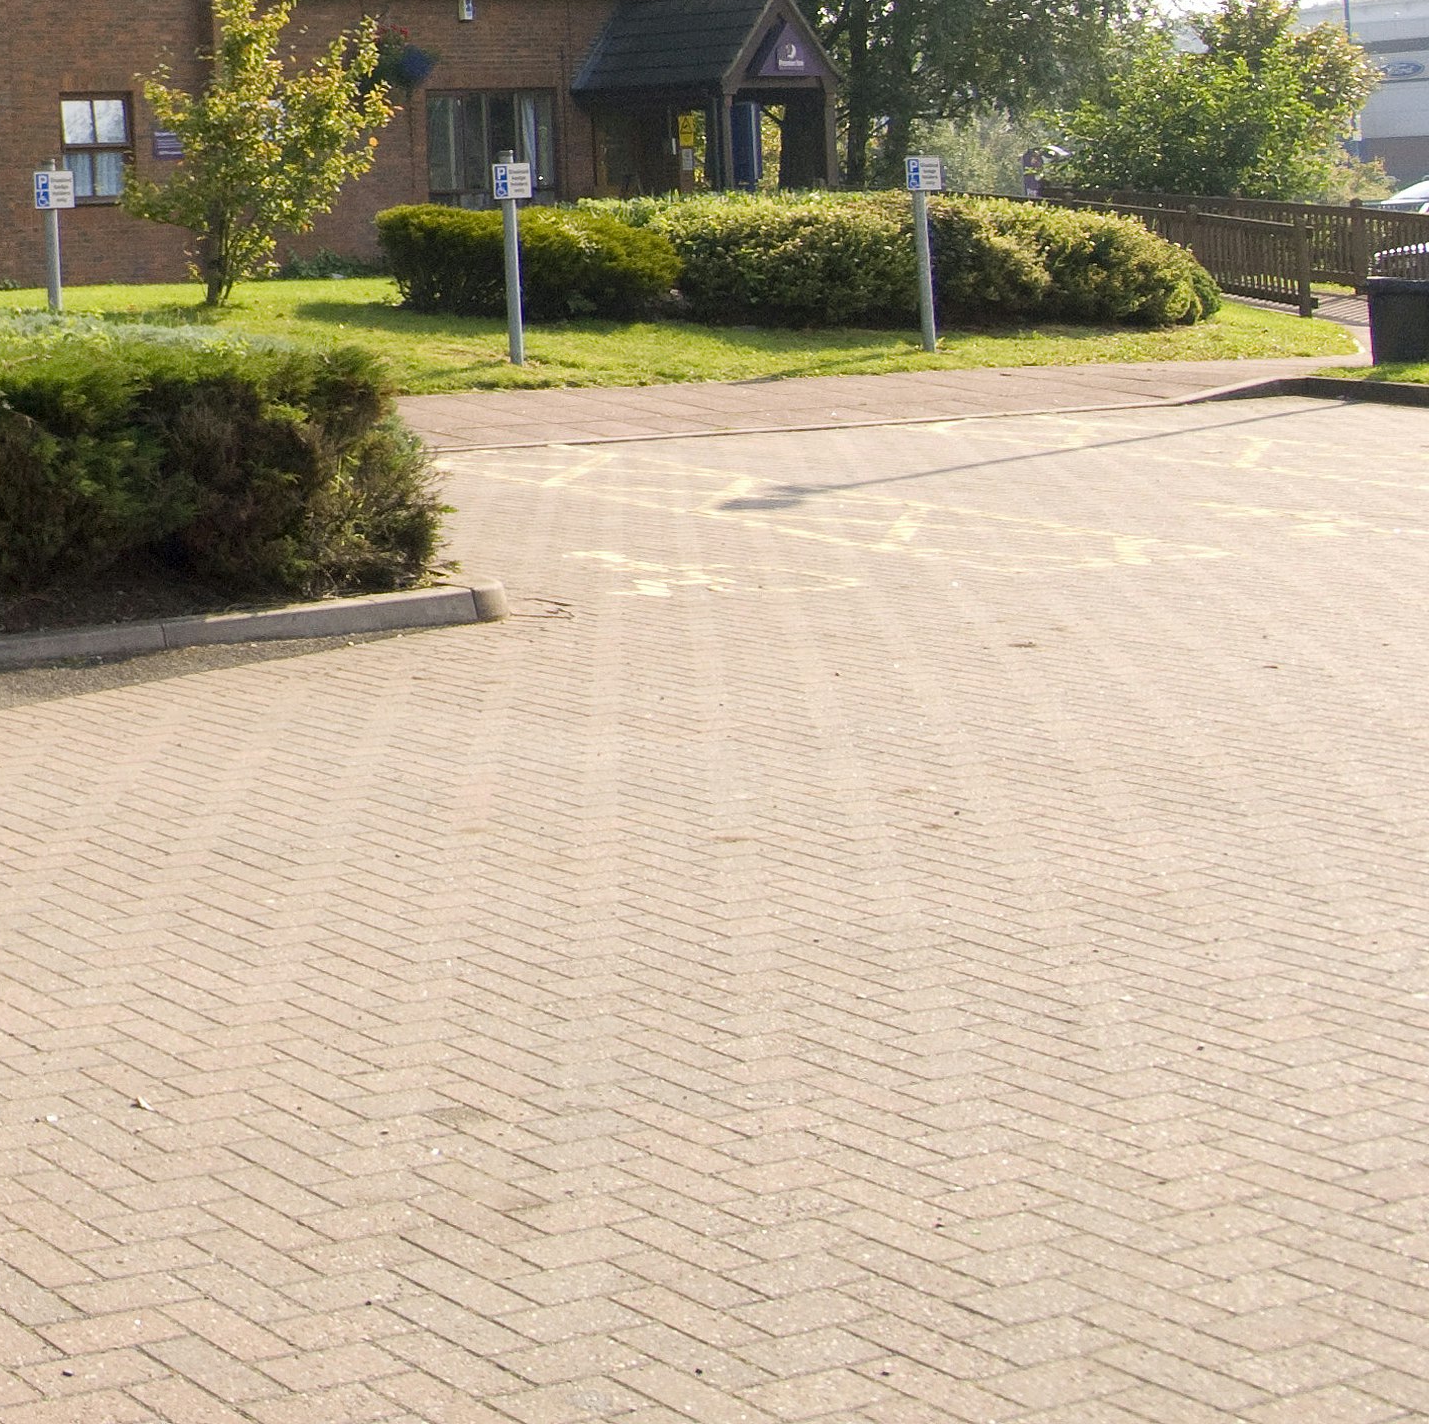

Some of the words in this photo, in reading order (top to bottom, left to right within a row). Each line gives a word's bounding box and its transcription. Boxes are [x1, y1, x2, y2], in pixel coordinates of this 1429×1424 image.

[909, 160, 918, 173] P
[496, 167, 506, 180] P
[38, 175, 48, 189] P
